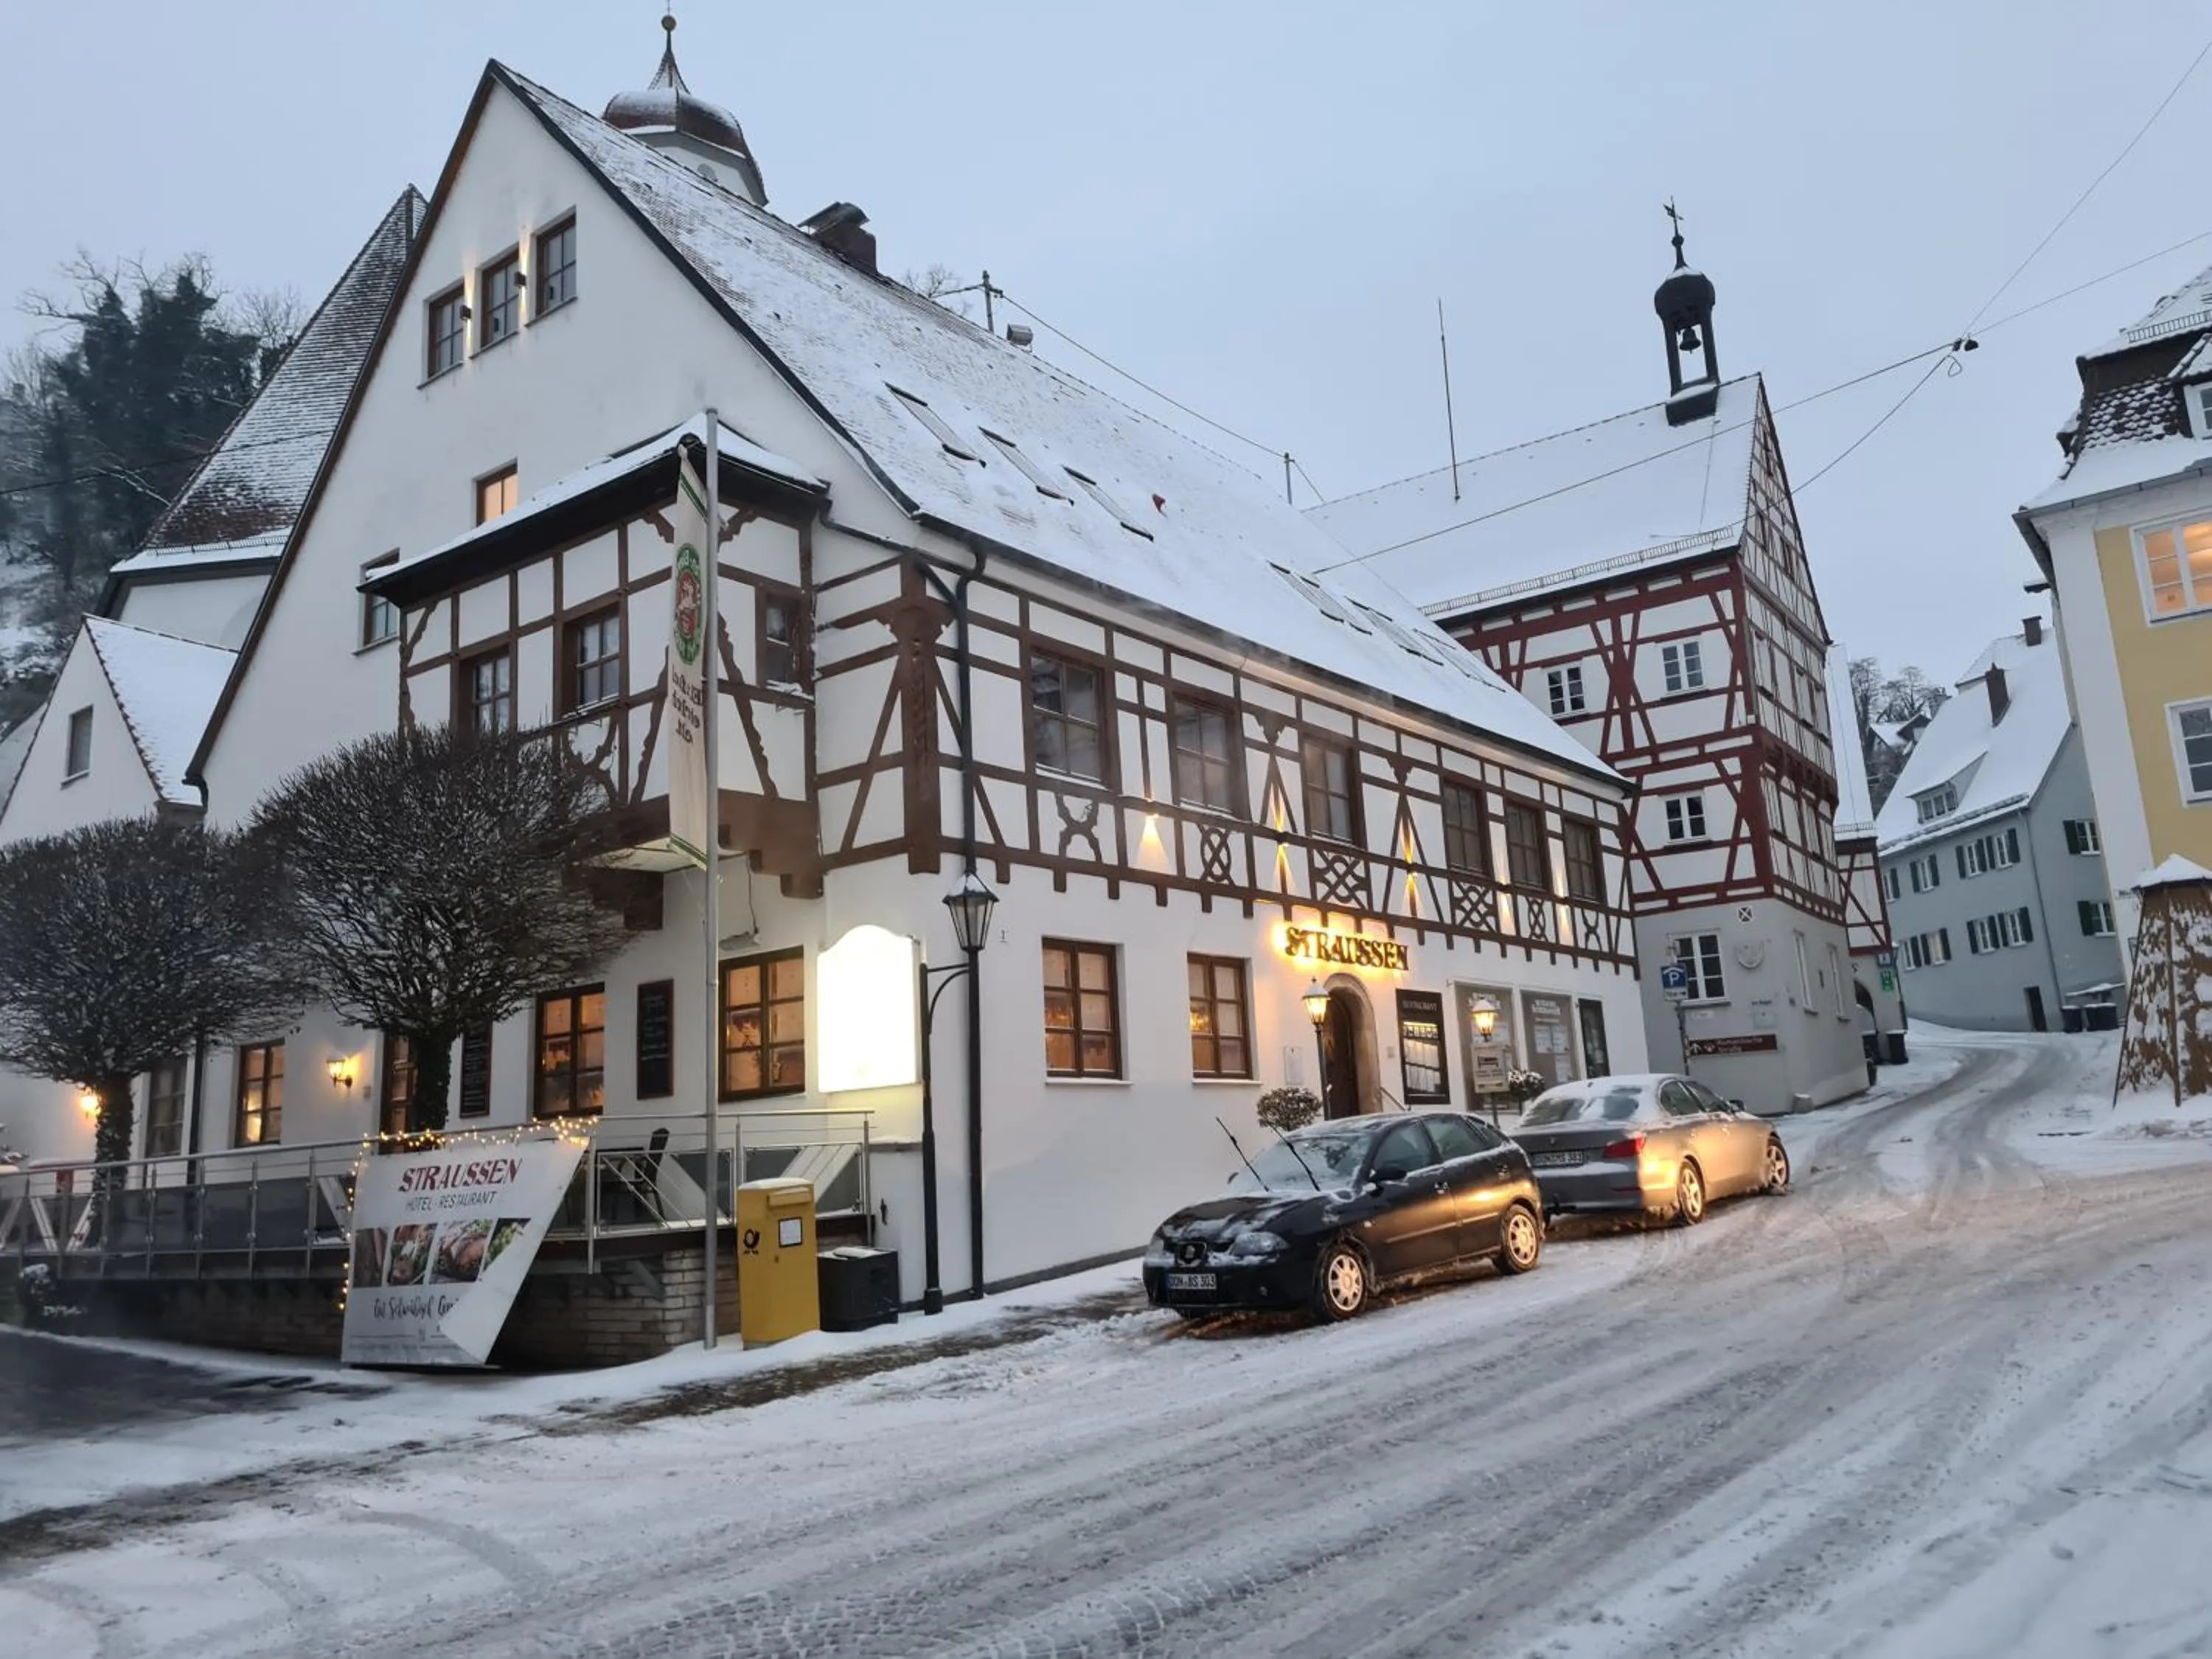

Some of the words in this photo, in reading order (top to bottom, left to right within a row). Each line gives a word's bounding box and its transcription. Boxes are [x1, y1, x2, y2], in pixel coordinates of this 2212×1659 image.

[1285, 927, 1409, 971] STRAUSSEN
[1669, 972, 1679, 986] P
[398, 1158, 523, 1192] STRAUSSEN
[439, 1191, 498, 1209] RESTAURANT
